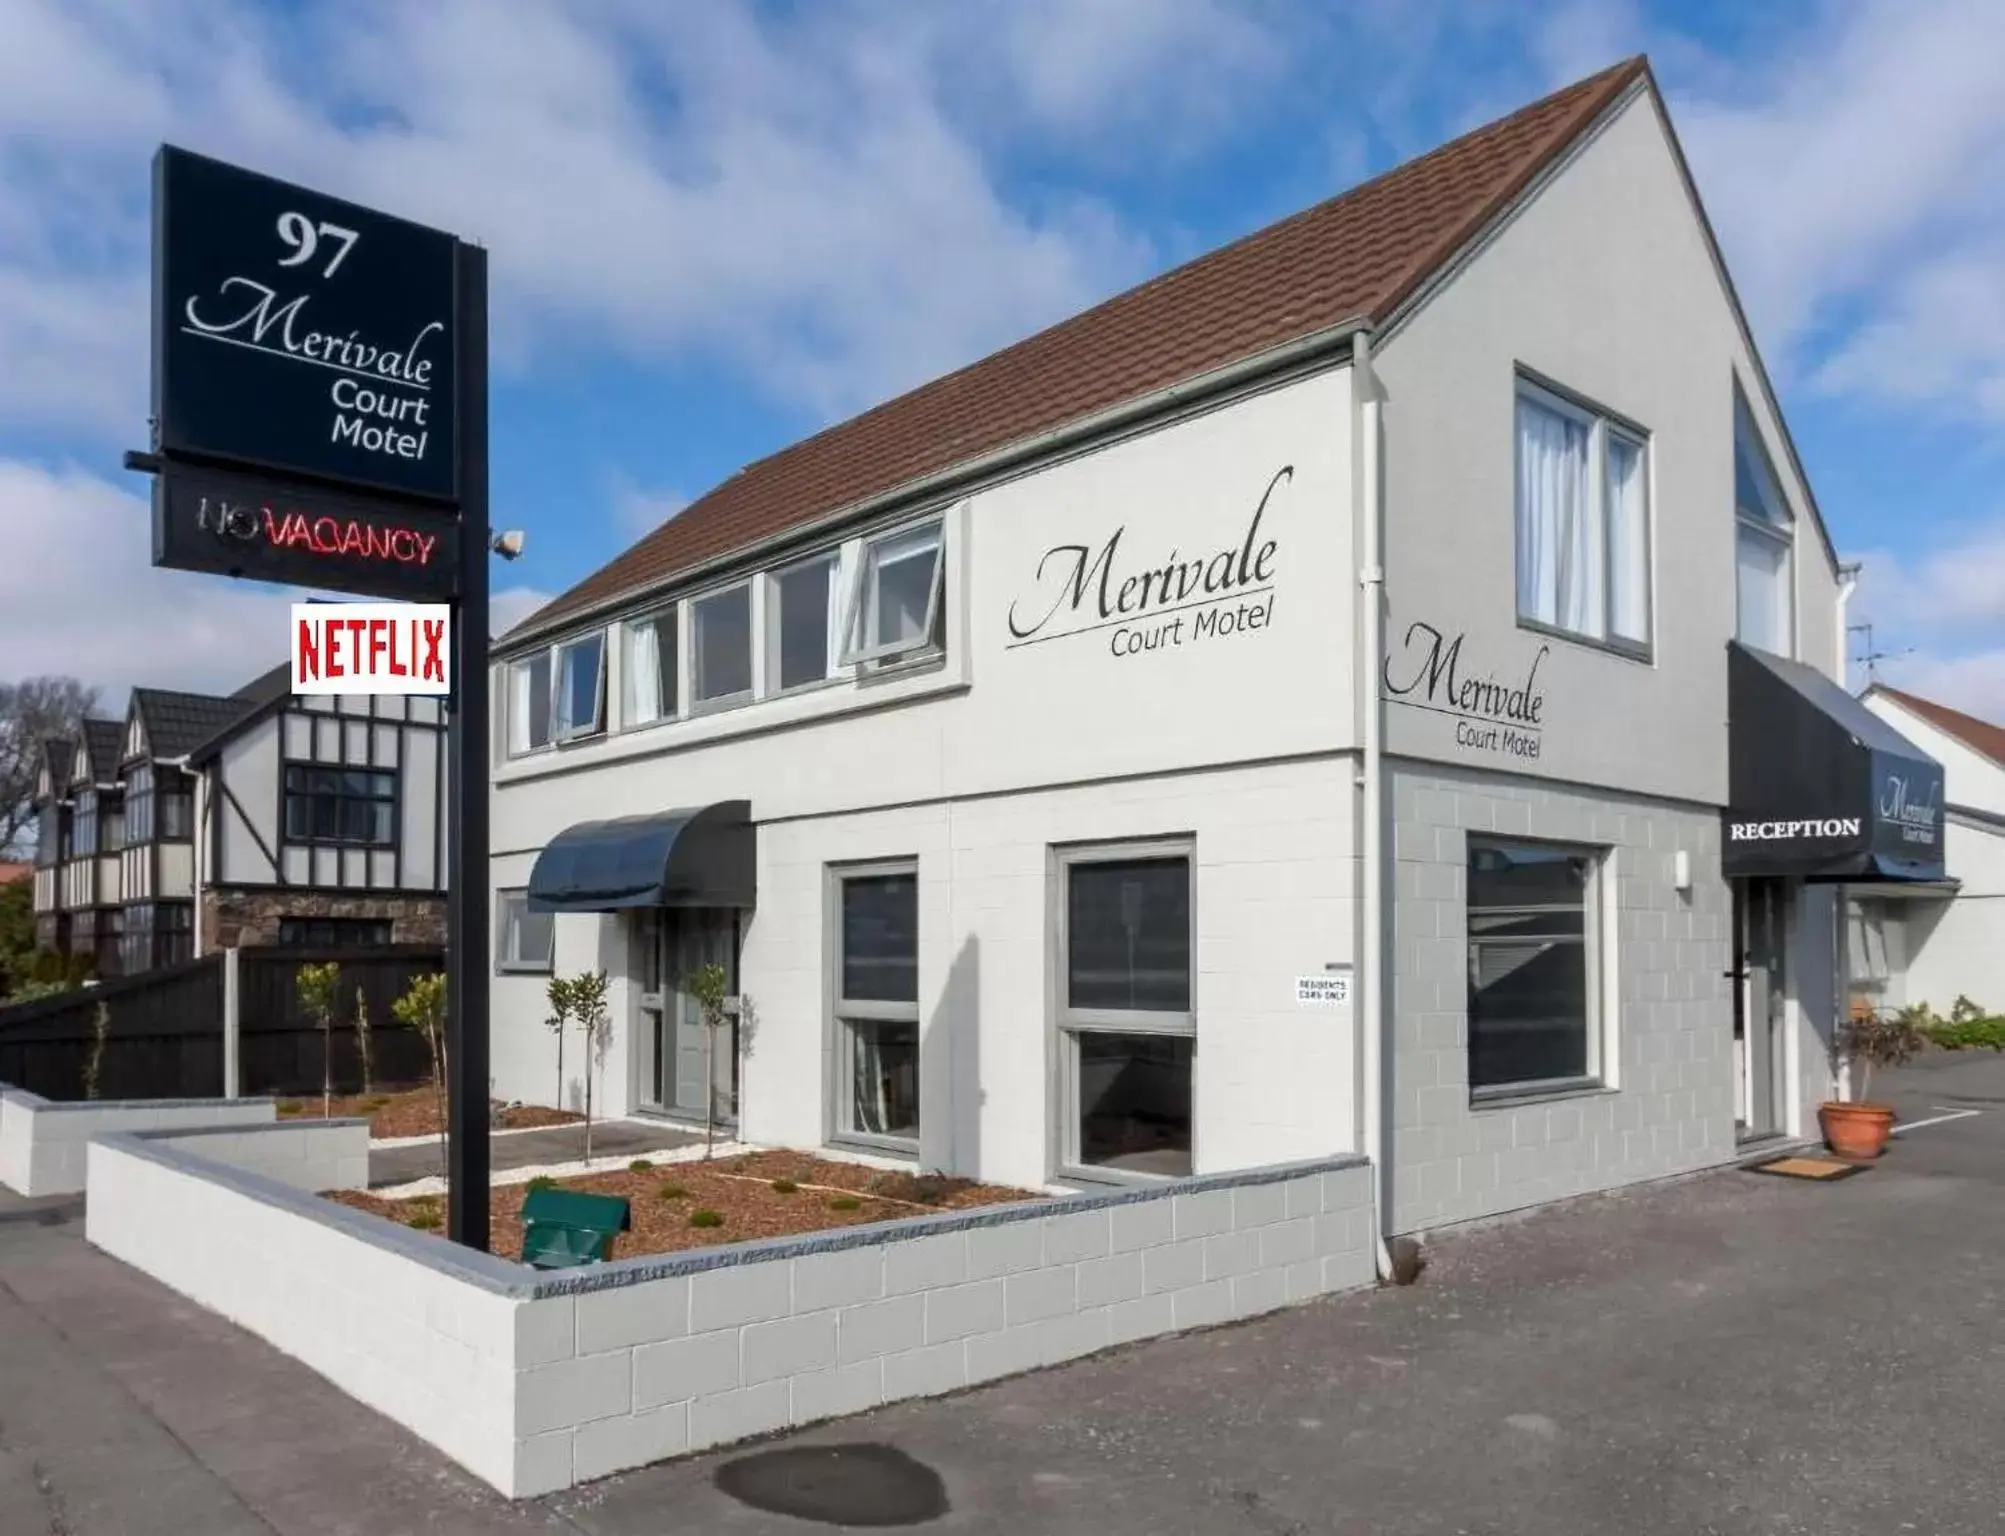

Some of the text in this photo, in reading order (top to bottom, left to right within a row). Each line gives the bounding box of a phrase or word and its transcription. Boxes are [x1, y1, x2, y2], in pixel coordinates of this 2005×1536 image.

[276, 212, 358, 277] 97
[185, 277, 444, 383] Merivale
[332, 378, 429, 424] Court
[332, 414, 427, 459] Motel
[262, 507, 435, 564] VACANCY
[1008, 465, 1293, 637] Merivale
[1111, 595, 1274, 657] Court Motel
[1384, 622, 1549, 724] Merivale
[1457, 721, 1541, 758] Court Motel
[1731, 818, 1861, 840] RECEPTION
